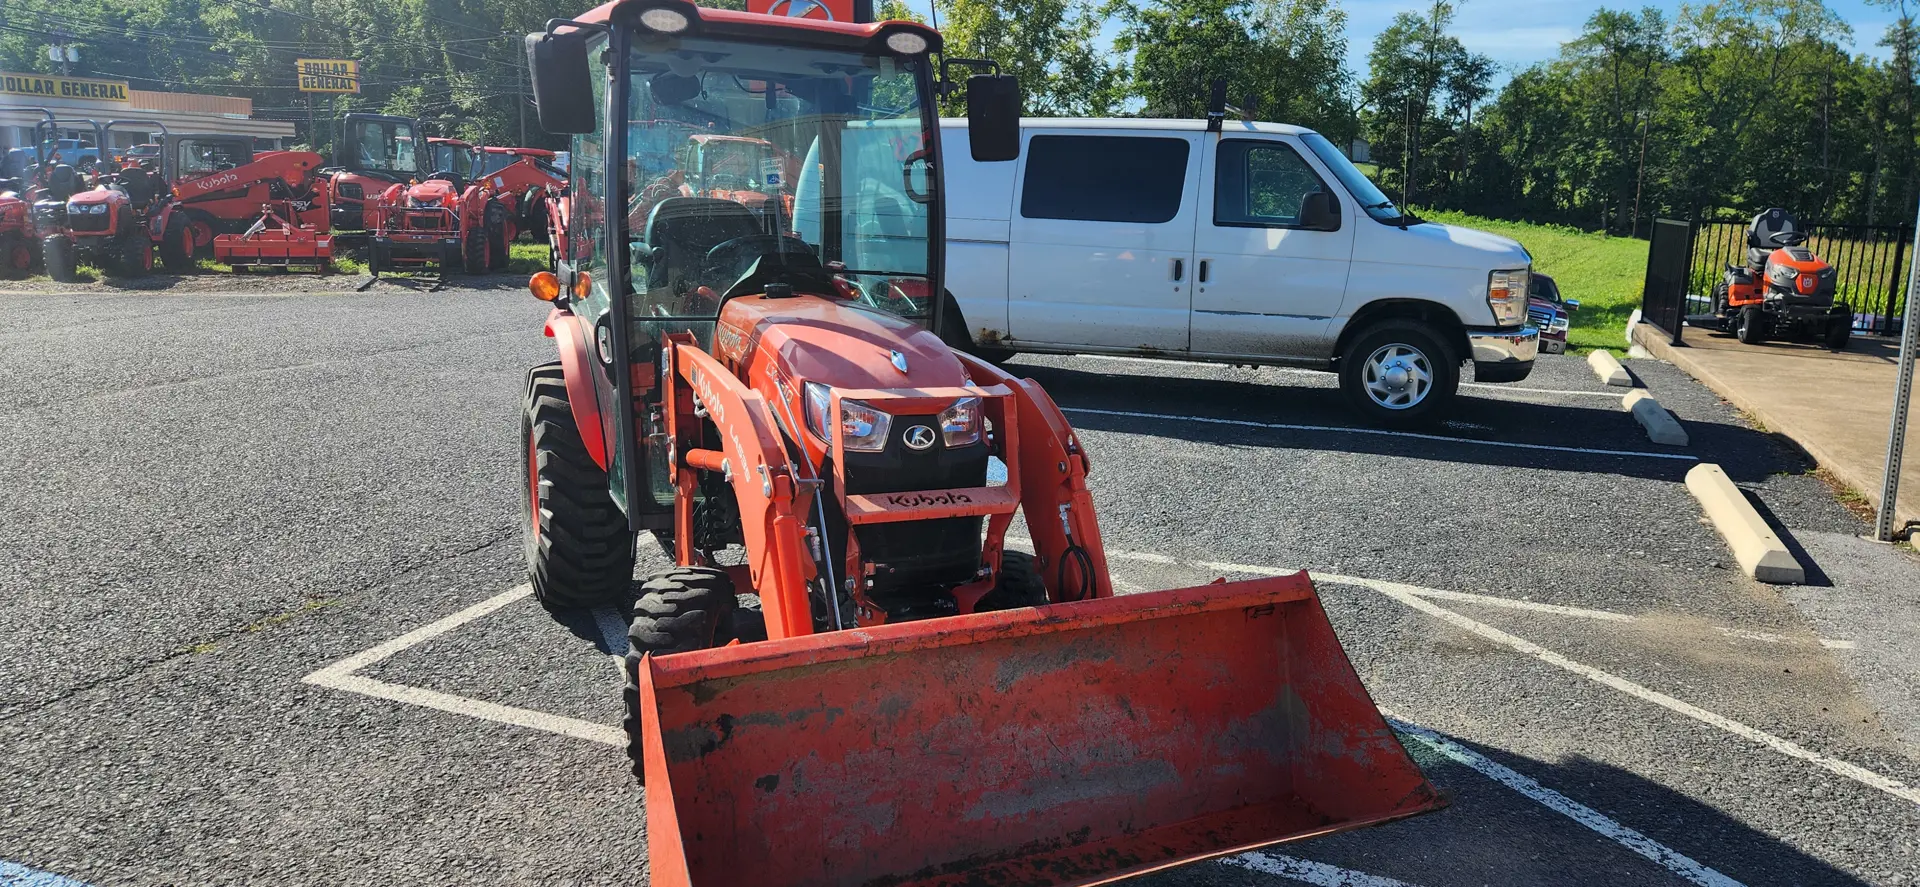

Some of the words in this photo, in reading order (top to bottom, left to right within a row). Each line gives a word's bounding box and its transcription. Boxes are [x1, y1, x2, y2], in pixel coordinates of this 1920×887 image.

[304, 62, 349, 76] DOLLAR
[61, 81, 127, 100] GENERAL
[302, 76, 354, 90] GENERAL
[197, 173, 238, 189] Kubota
[697, 368, 725, 424] Kubota
[887, 491, 973, 508] Kubota
